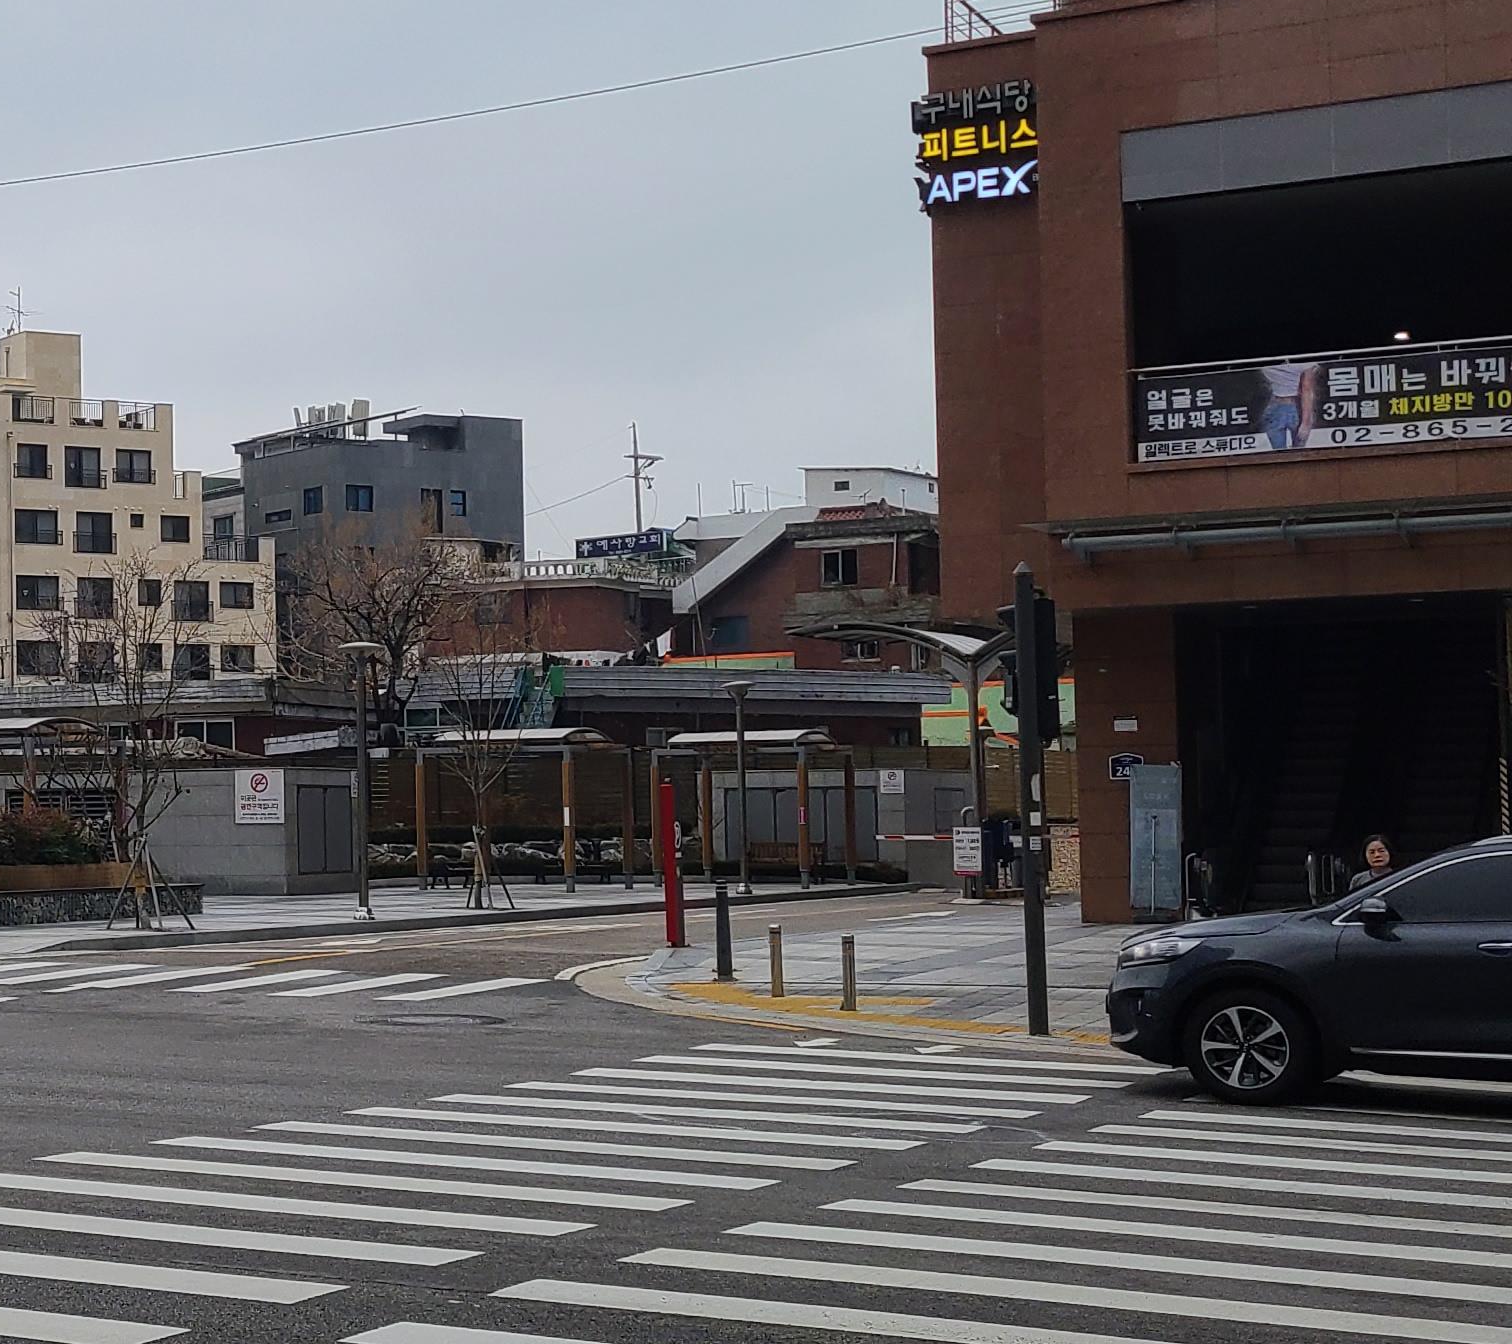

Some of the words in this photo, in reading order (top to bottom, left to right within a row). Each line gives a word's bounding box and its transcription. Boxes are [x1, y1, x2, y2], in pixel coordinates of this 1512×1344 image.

[921, 79, 1031, 125] 구내식당
[923, 118, 1038, 161] 피트니스
[927, 159, 1038, 204] APEX
[1327, 363, 1427, 397] 몸매는
[1440, 356, 1512, 387] 바꿔
[1147, 388, 1214, 410] 얼굴은
[1322, 399, 1380, 421] 3개월
[1388, 391, 1475, 415] 체지방만
[1145, 442, 1197, 458] 일렉트로
[1202, 436, 1257, 454] 스튜디오
